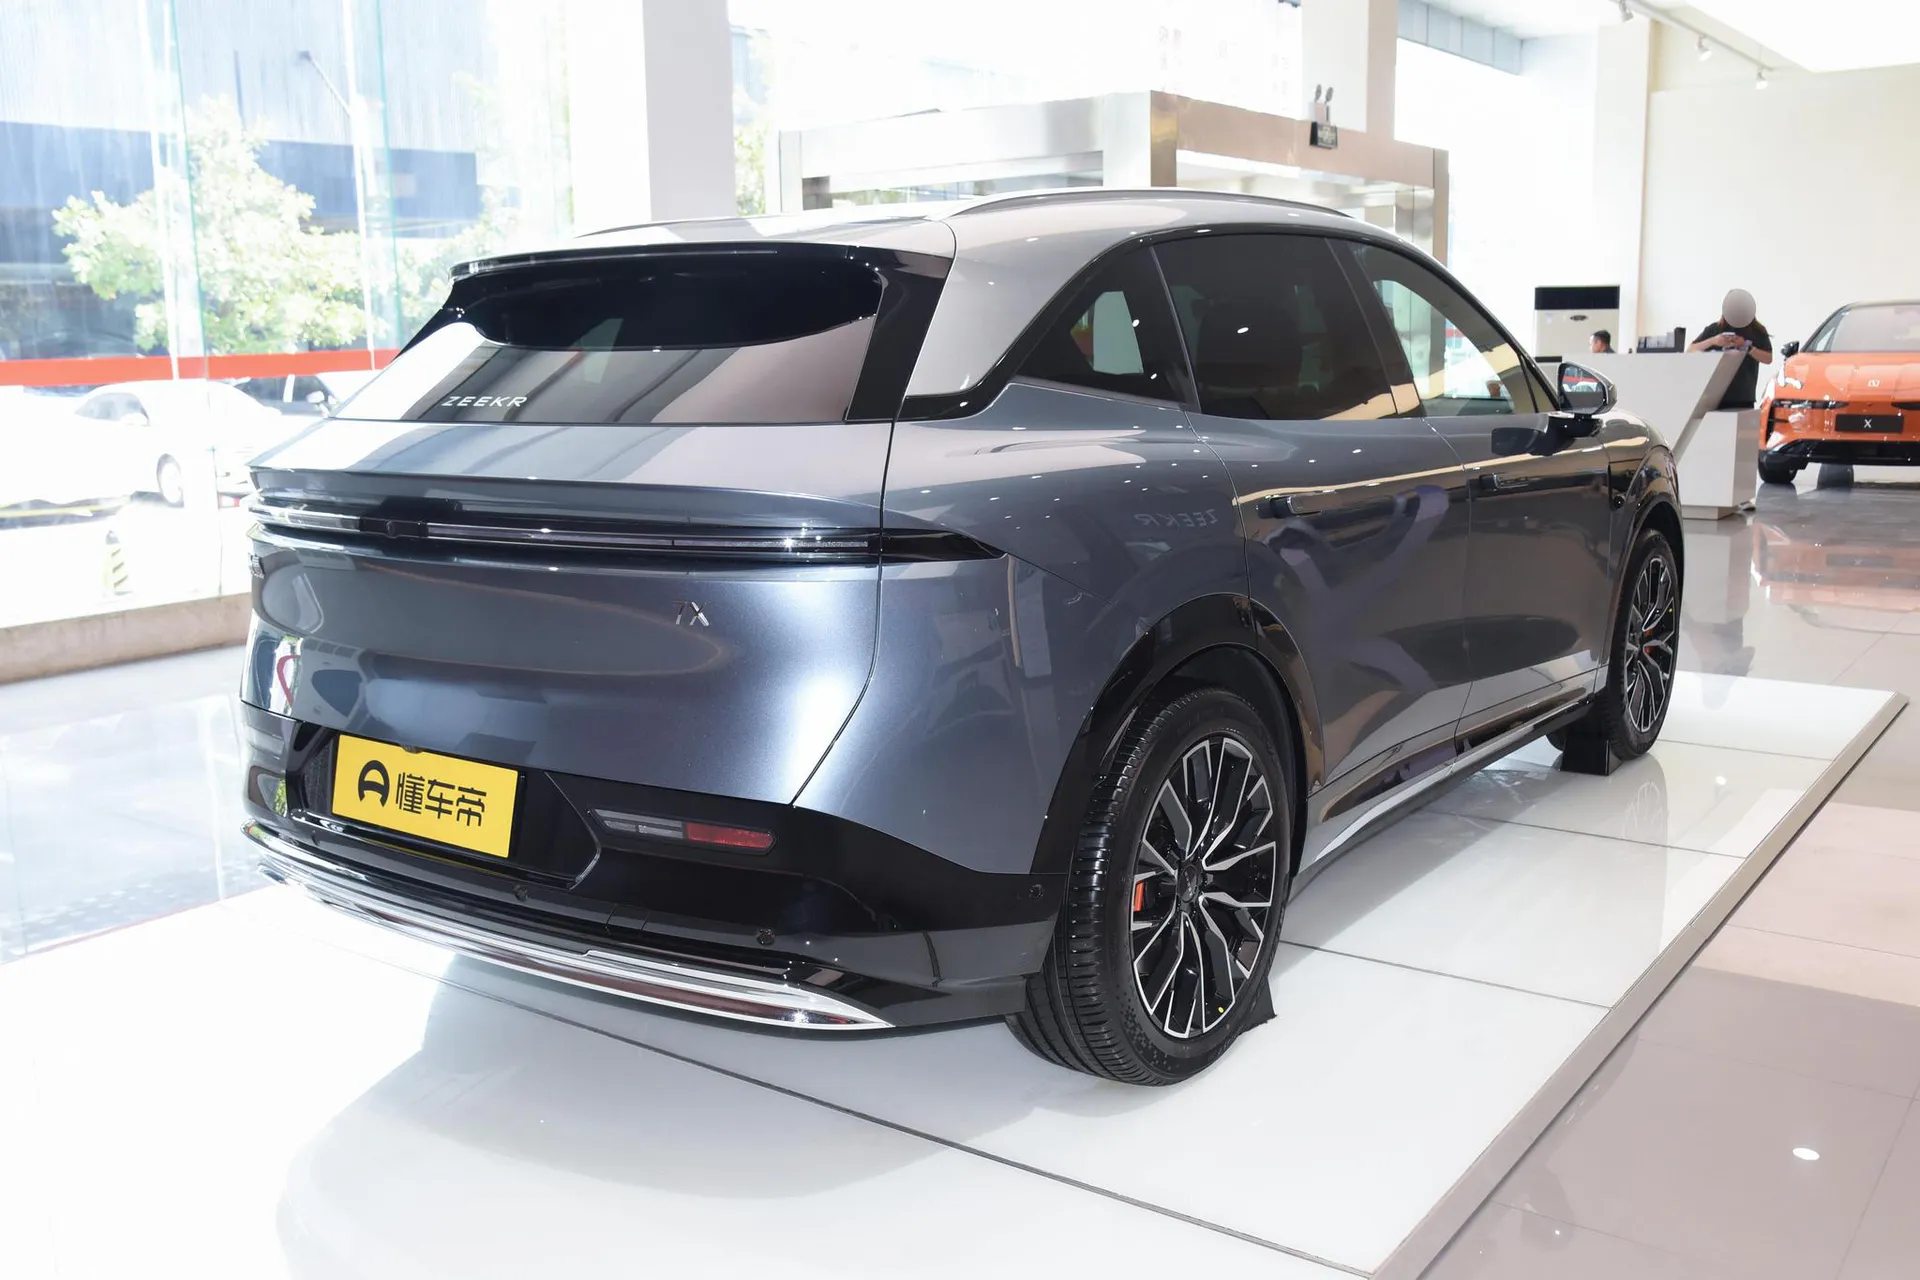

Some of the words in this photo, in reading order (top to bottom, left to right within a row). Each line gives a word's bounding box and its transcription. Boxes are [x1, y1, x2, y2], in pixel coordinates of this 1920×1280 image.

[441, 395, 528, 408] ZEEKR
[1863, 418, 1873, 429] X
[671, 600, 710, 627] 7X
[395, 772, 487, 827] 懂车帝
